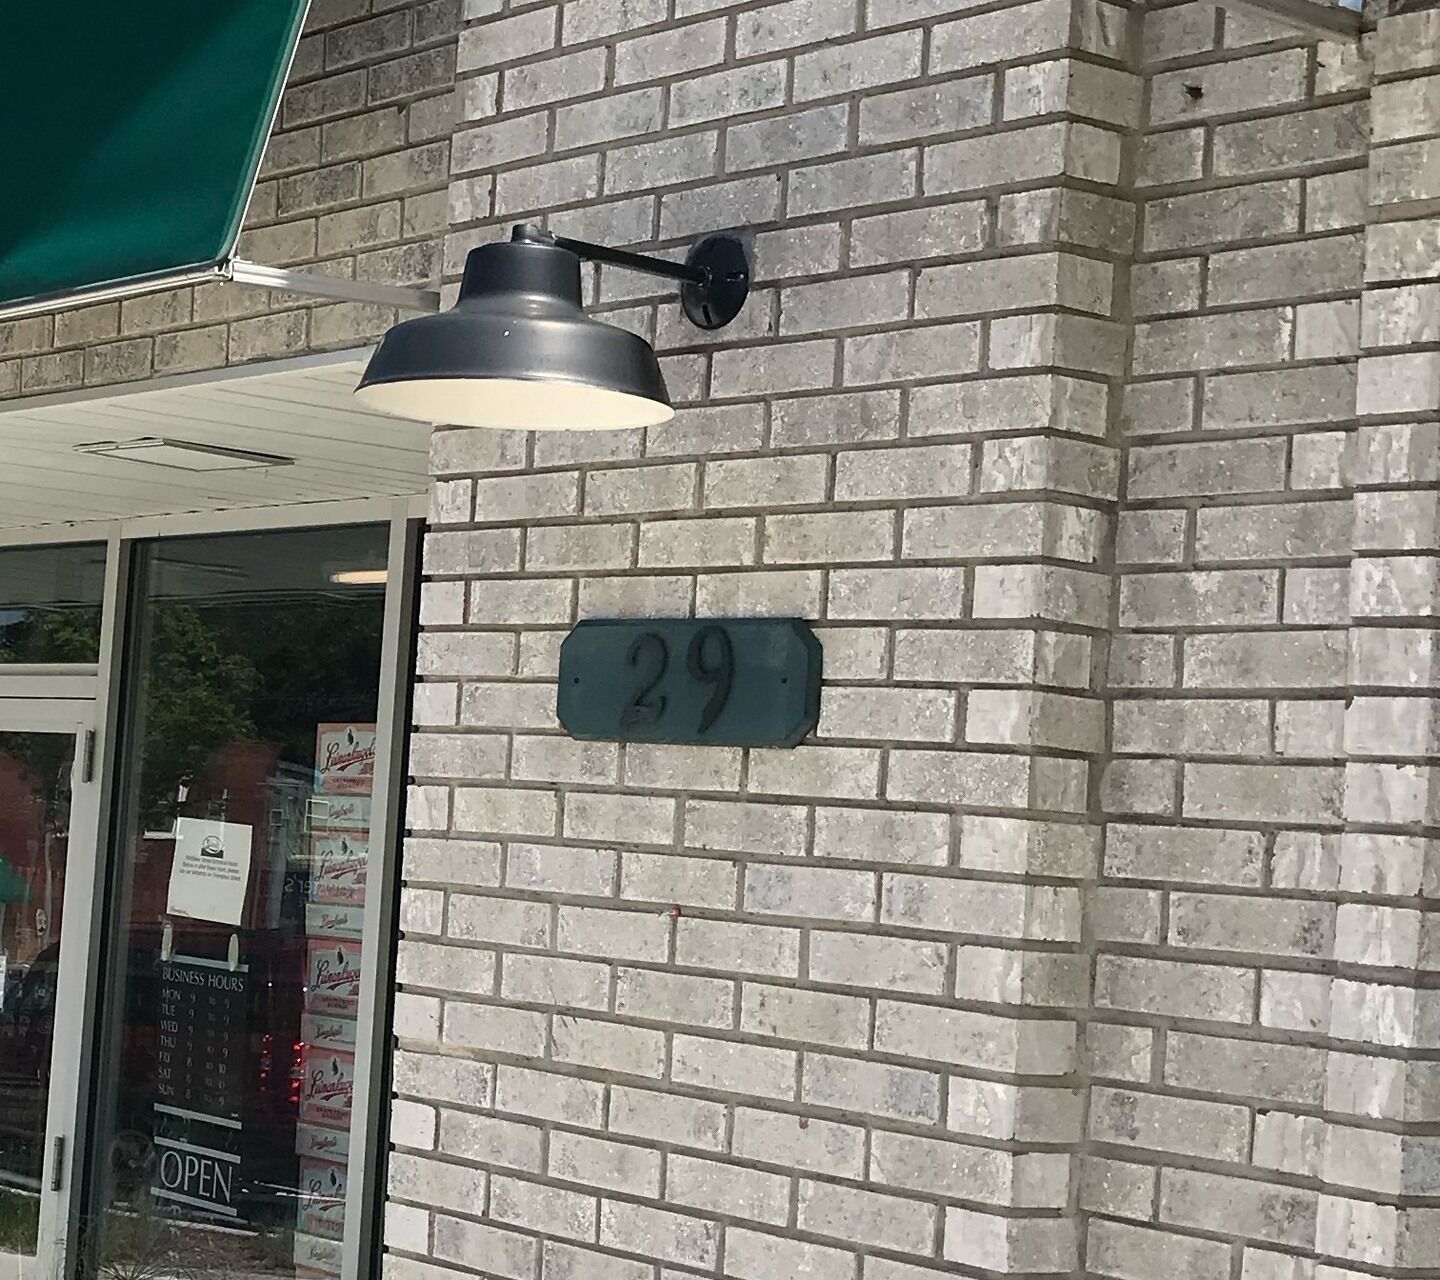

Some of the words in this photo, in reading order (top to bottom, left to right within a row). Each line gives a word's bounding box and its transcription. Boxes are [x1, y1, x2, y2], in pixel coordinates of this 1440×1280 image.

[620, 625, 735, 734] 29
[162, 967, 205, 986] BUSINESS
[208, 973, 244, 992] HOURS
[162, 987, 181, 1001] MON
[161, 1004, 176, 1017] TUE
[160, 1020, 178, 1033] WED
[160, 1035, 176, 1049] THU
[161, 1151, 233, 1203] OPEN
